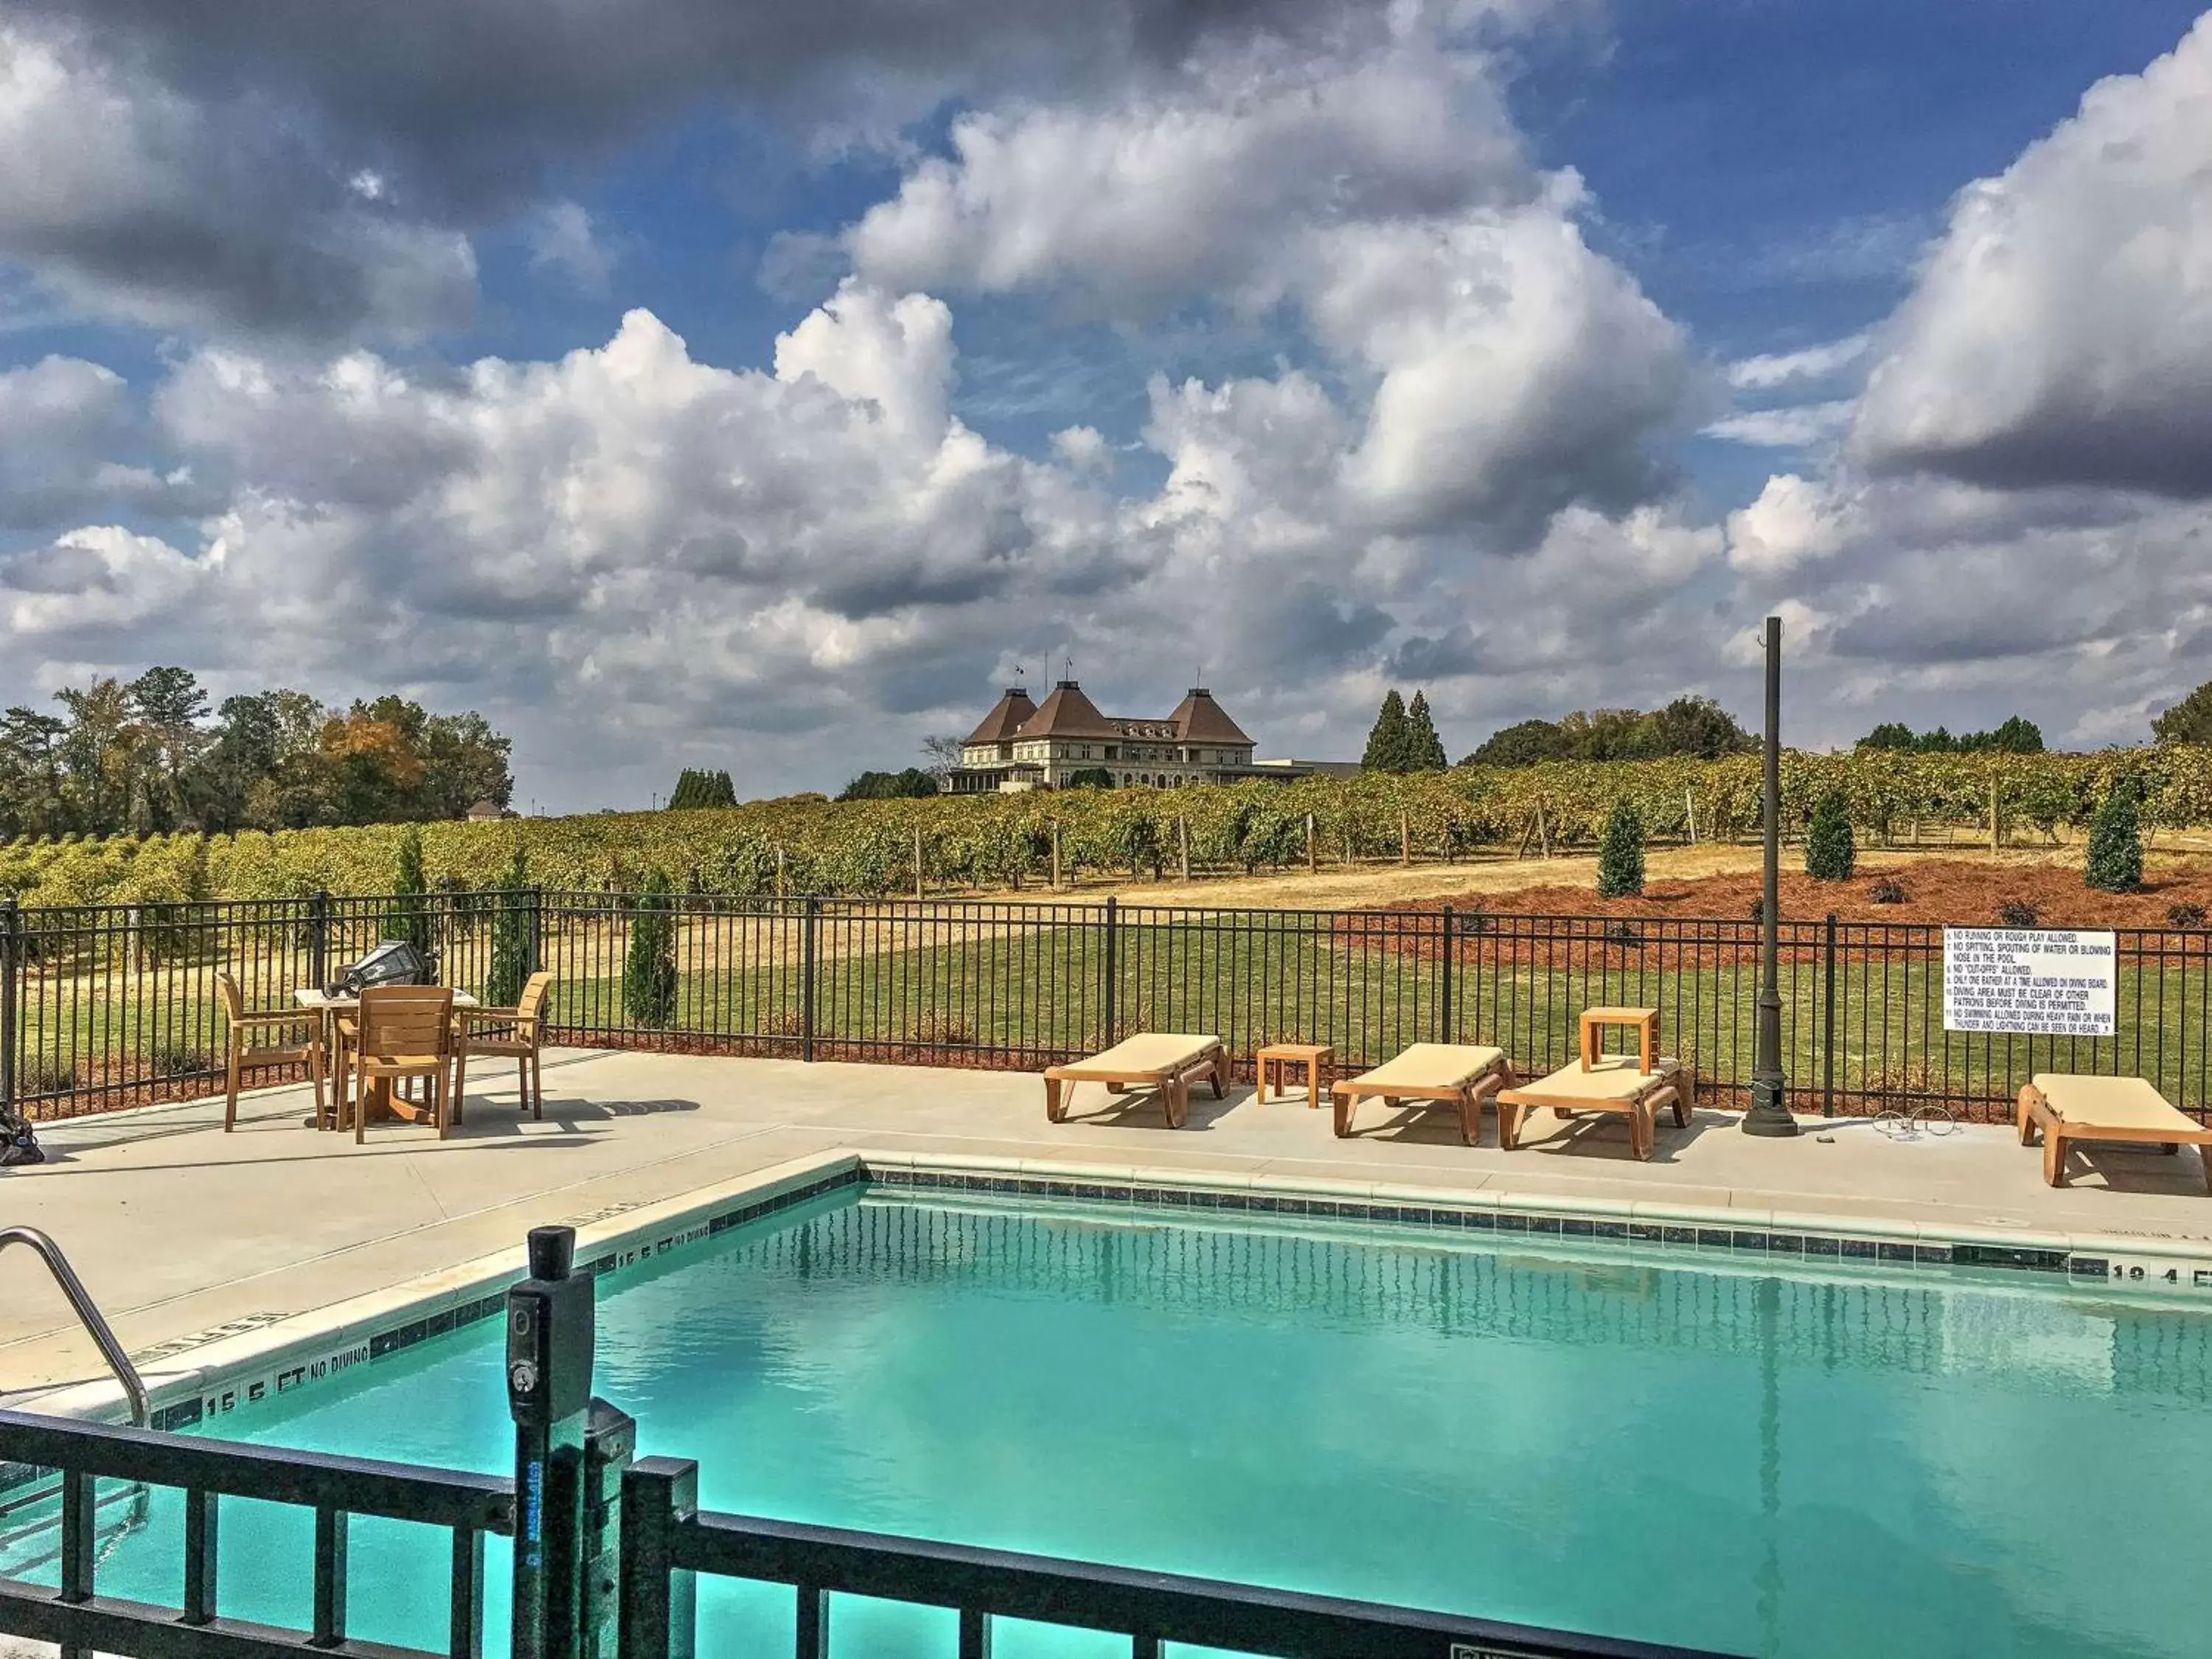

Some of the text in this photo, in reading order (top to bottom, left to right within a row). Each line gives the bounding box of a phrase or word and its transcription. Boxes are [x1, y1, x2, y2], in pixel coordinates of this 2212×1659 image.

[1954, 931, 1963, 939] NO
[1964, 931, 1991, 940] RUNNING
[1994, 932, 2003, 941] OR
[2006, 932, 2026, 941] ROUGH
[2029, 933, 2045, 942] PLAY
[1954, 942, 1963, 950] NO
[1997, 944, 2029, 953] SPOUTING
[2032, 944, 2041, 953] OF
[2044, 945, 2066, 954] WATER
[2069, 945, 2078, 954] OR
[2081, 945, 2110, 955] BLOWING
[1954, 953, 1970, 961] NOSE
[1973, 954, 1979, 962] IN
[1983, 954, 1994, 963] THE
[1954, 964, 1963, 973] NO
[1969, 976, 1979, 985] ONE
[1982, 976, 2002, 985] BATHER
[2004, 976, 2011, 985] AT
[2013, 977, 2017, 985] A
[2019, 978, 2031, 987] TIME
[2033, 978, 2057, 987] ALLOWED
[2059, 978, 2067, 987] ON
[2069, 979, 2087, 988] DIVING
[1954, 987, 1975, 995] DIVING
[1978, 988, 1995, 997] AREA
[1998, 988, 2014, 997] MUST
[2019, 990, 2027, 998] BE
[2031, 990, 2051, 998] CLEAR
[2054, 990, 2063, 998] OF
[2066, 991, 2088, 1000] OTHER
[1954, 997, 1983, 1007] PATRONS
[1986, 998, 2011, 1007] BEFORE
[2016, 1000, 2037, 1009] DIVING
[2039, 1000, 2045, 1009] IS
[1954, 1009, 1963, 1018] NO
[1964, 1009, 1992, 1018] SWIMMING
[1995, 1010, 2020, 1019] ALLOWED
[2023, 1011, 2044, 1020] DURING
[2047, 1012, 2065, 1020] HEAVY
[2067, 1013, 2081, 1022] RAIN
[2082, 1013, 2091, 1022] OR
[2094, 1013, 2110, 1023] WHEN
[1955, 1019, 1979, 1029] THUNDER
[1982, 1020, 1994, 1029] AND
[1996, 1021, 2025, 1031] LIGHTNING
[2028, 1022, 2039, 1031] CAN
[2041, 1023, 2048, 1032] BE
[2051, 1023, 2066, 1032] SEEN
[2069, 1023, 2076, 1032] OR
[657, 1237, 672, 1253] FT
[2194, 1270, 2212, 1283] F
[248, 1382, 265, 1400] 5
[278, 1367, 305, 1391] FT
[310, 1360, 327, 1380] NO
[331, 1346, 368, 1374] DIVING
